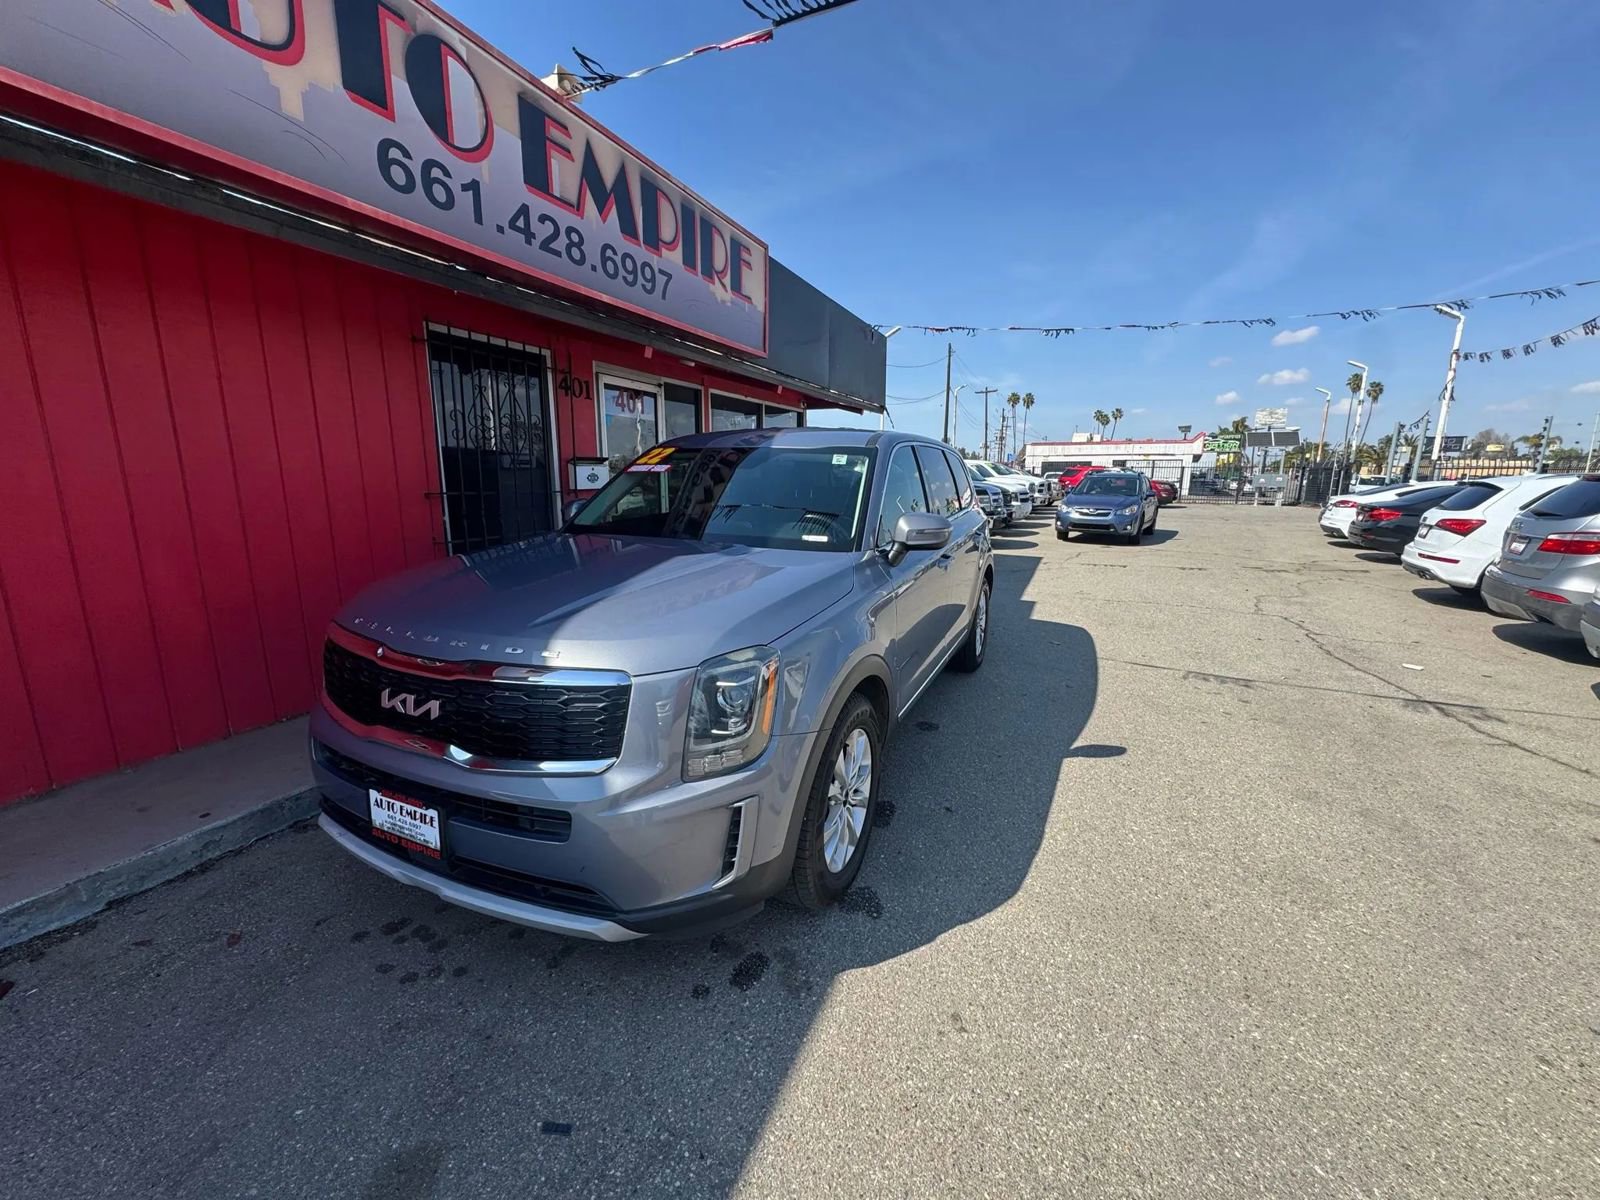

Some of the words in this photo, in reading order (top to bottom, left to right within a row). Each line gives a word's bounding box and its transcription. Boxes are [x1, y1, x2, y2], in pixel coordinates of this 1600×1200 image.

[518, 93, 753, 304] EMPIRE
[376, 137, 673, 300] 661.428.6997
[558, 374, 592, 400] 401
[614, 388, 645, 415] 401
[634, 447, 677, 465] 22
[381, 688, 442, 721] KIA
[373, 796, 398, 814] AUTO
[400, 804, 437, 829] EMPIRE
